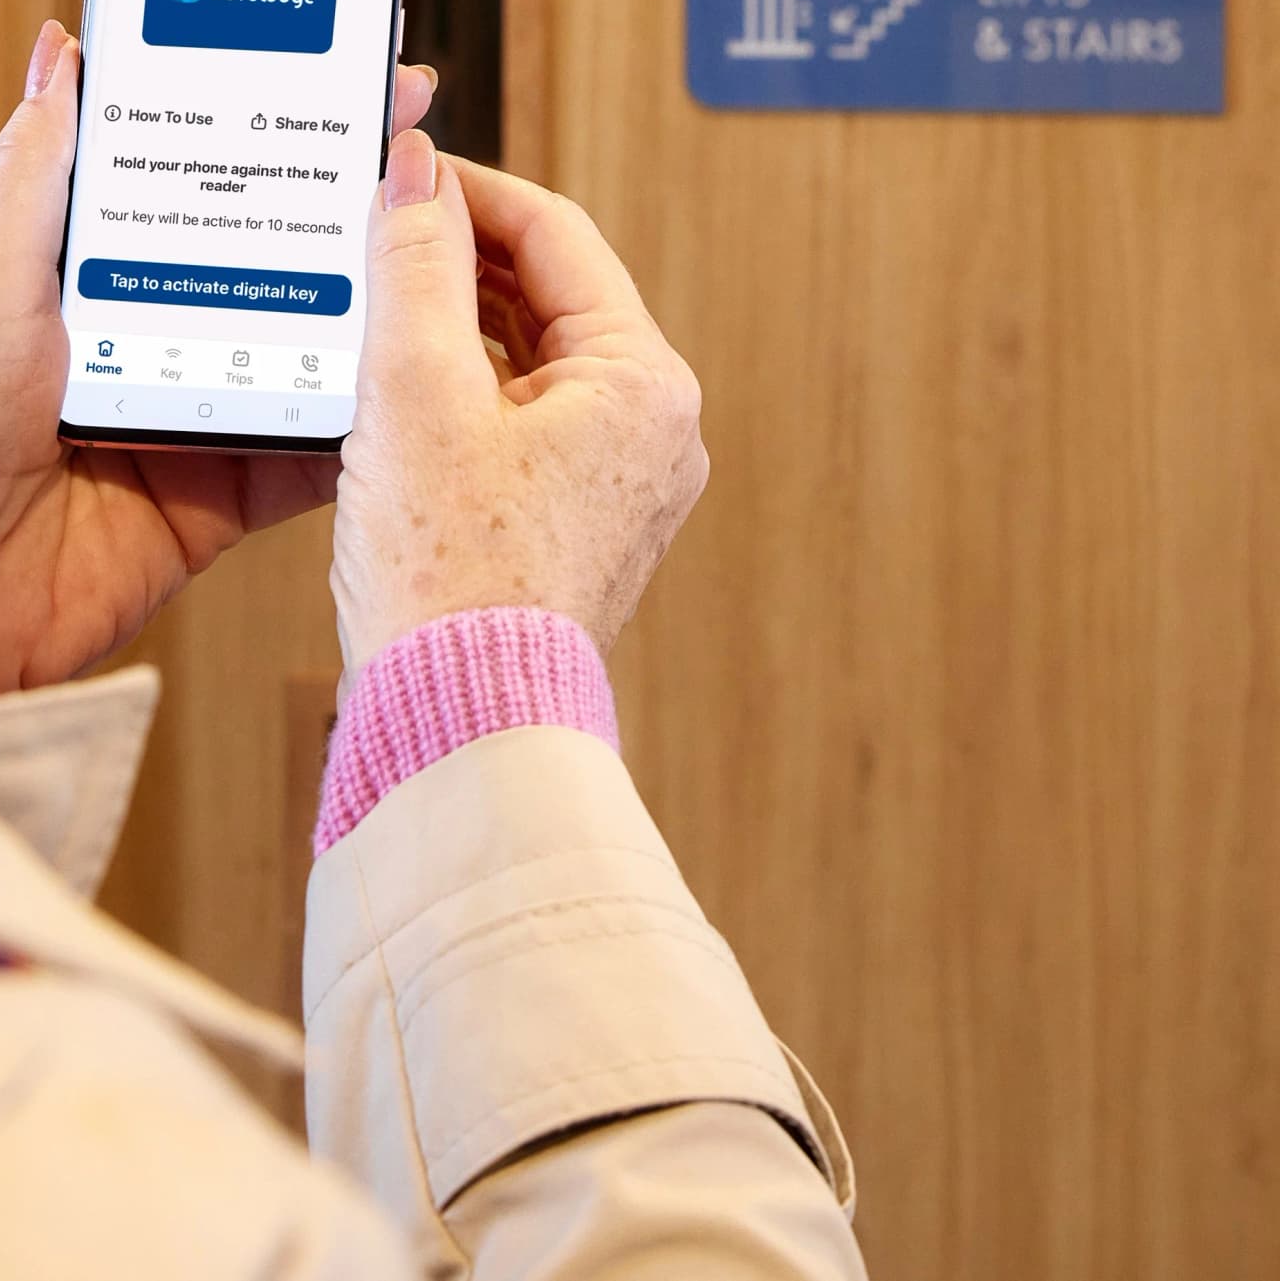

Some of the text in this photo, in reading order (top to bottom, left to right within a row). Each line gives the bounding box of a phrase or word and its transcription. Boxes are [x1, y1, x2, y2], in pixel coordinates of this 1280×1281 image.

[974, 18, 1184, 64] & STAIRS
[128, 108, 214, 125] How To Use
[275, 116, 349, 136] Share Key
[113, 156, 338, 184] Hold your phone against the key
[200, 179, 247, 193] reader
[100, 208, 343, 235] Your key will be active for 10 seconds
[110, 273, 319, 304] Tap to activate digital key
[86, 362, 123, 375] Home
[160, 368, 182, 382] Key
[225, 372, 254, 386] Trips
[293, 377, 323, 390] Chat
